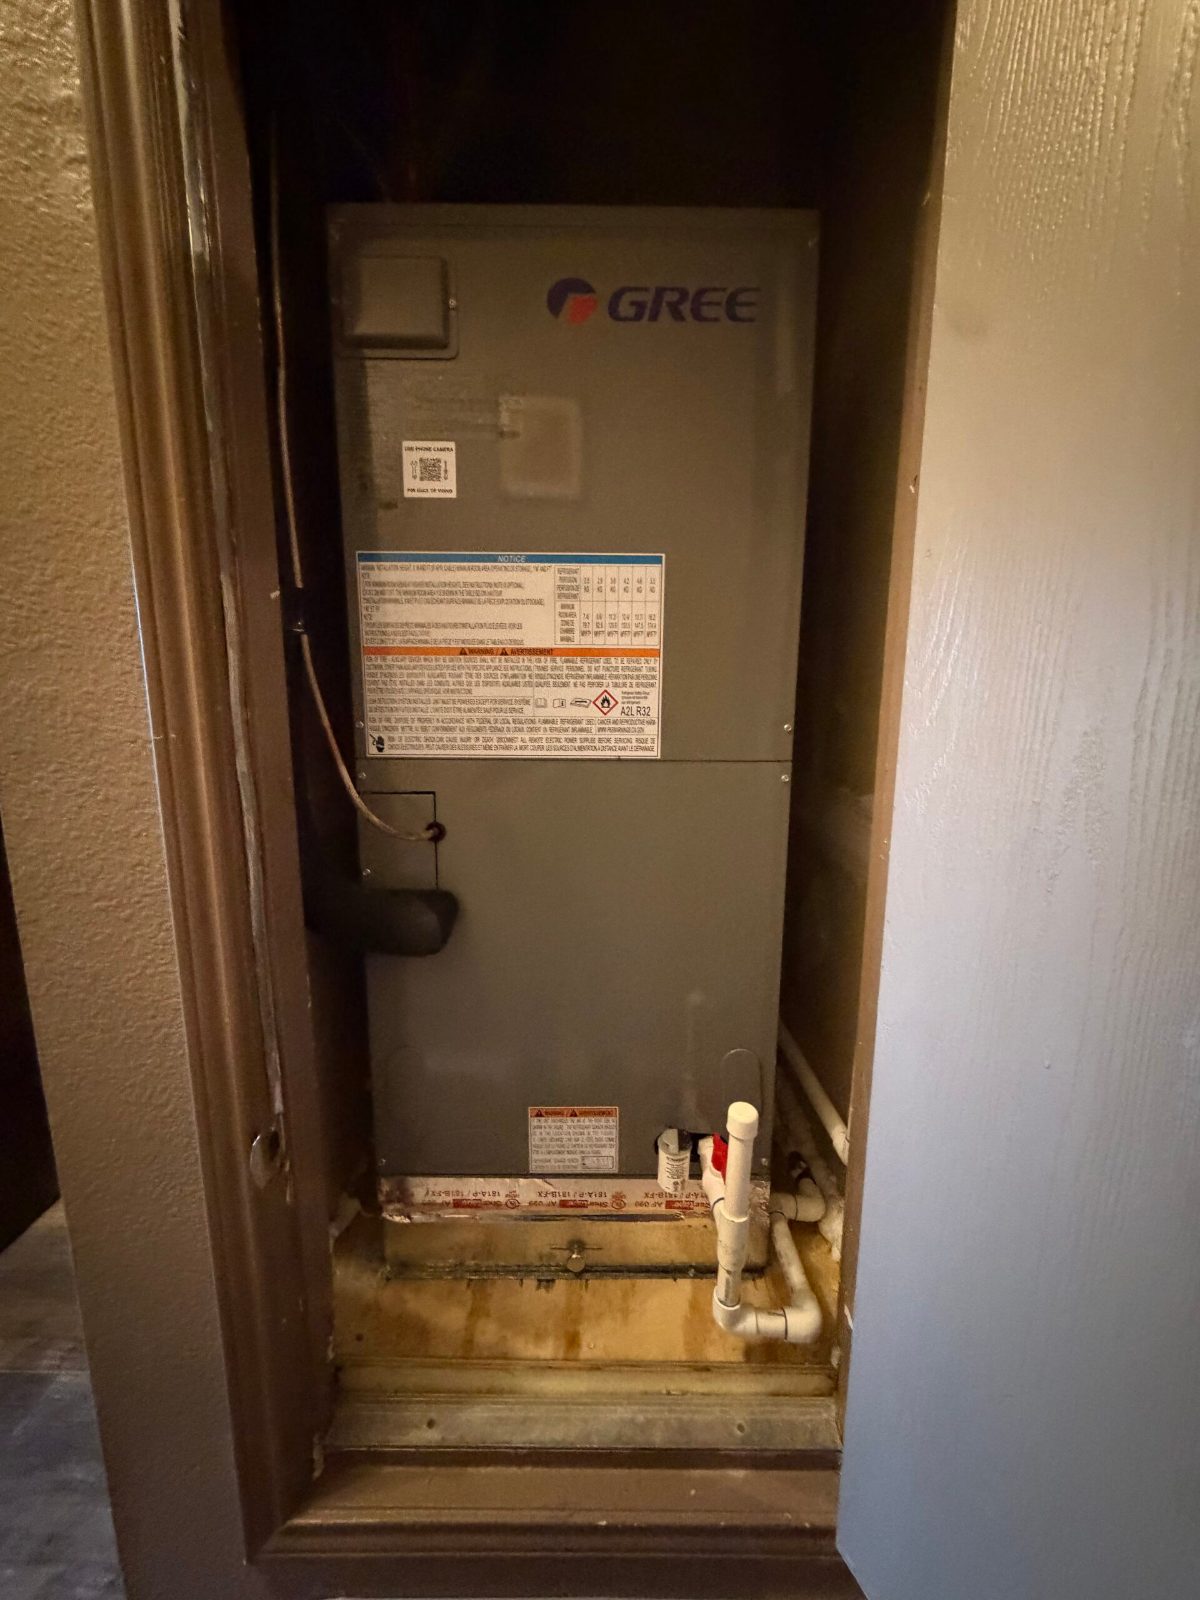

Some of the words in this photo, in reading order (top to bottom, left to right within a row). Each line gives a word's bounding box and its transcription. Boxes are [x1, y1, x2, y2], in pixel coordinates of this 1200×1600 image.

[607, 286, 760, 322] GREE
[620, 706, 634, 716] A2L
[636, 706, 651, 716] R32
